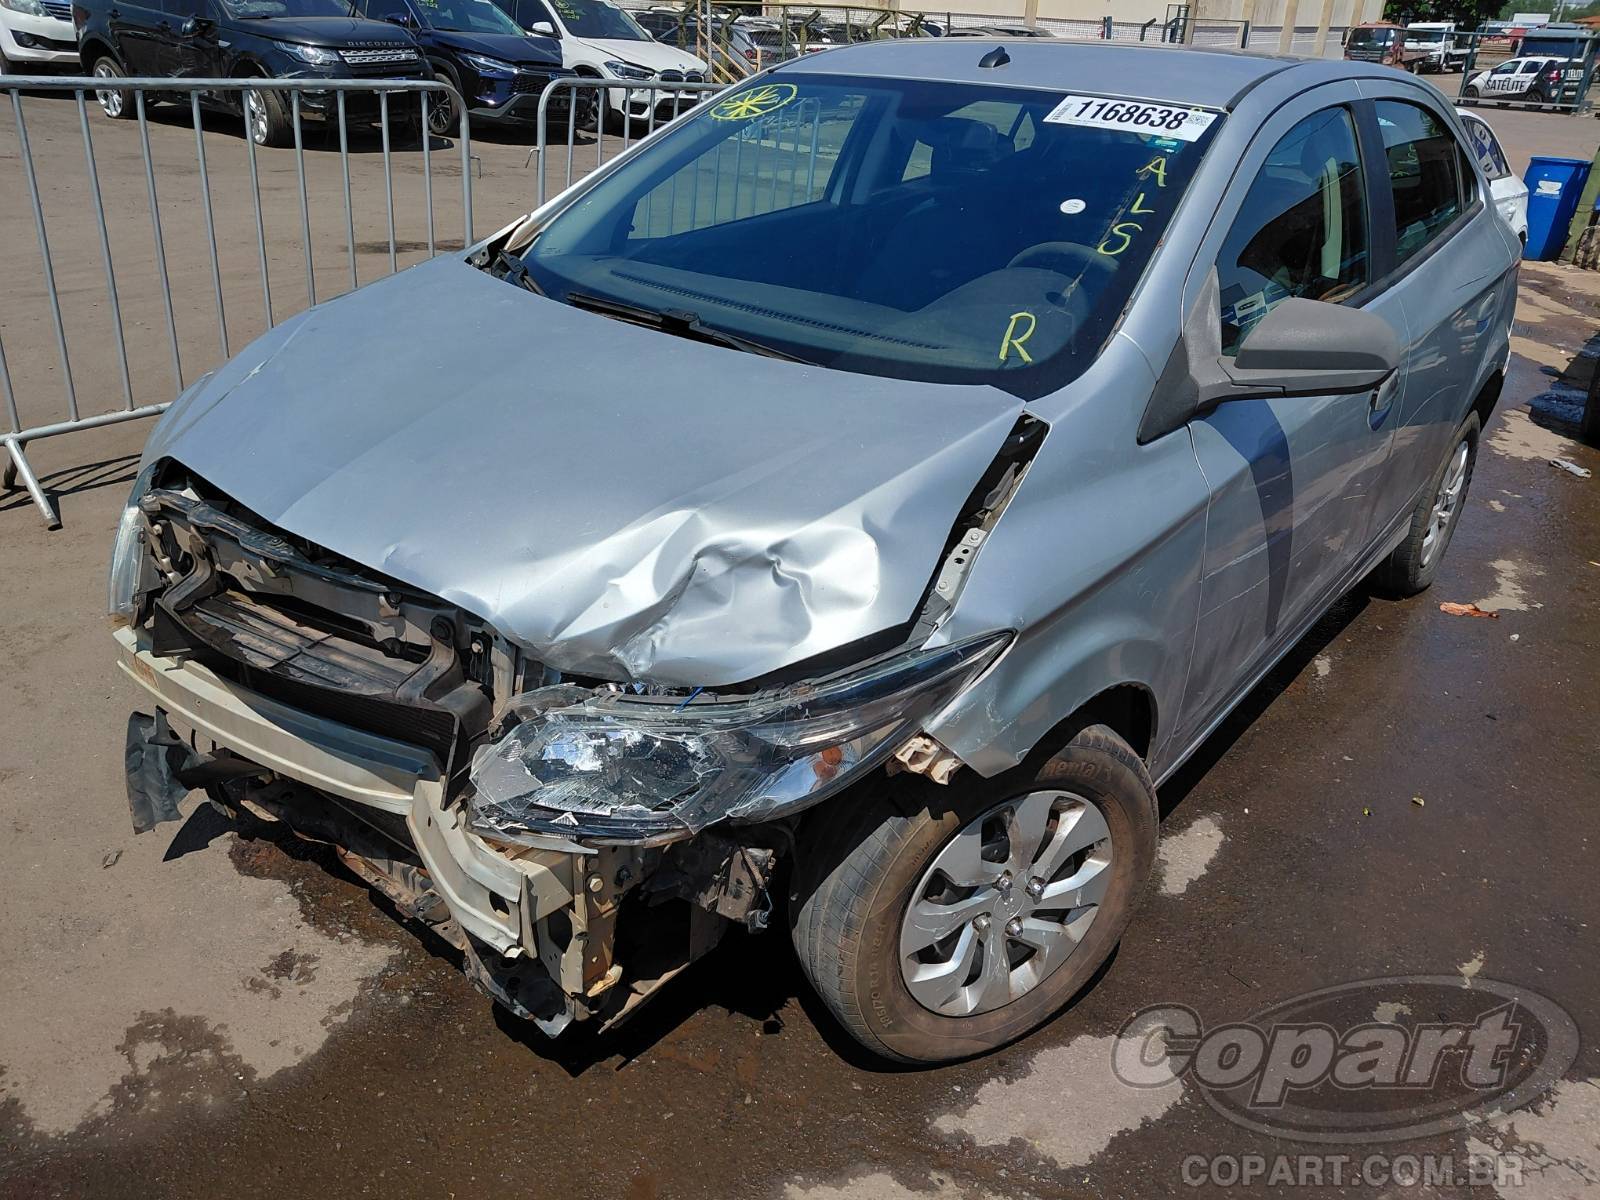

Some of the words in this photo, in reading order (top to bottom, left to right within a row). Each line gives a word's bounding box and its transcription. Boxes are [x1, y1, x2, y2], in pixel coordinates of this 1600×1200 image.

[1560, 68, 1585, 78] STÉLITE
[1075, 100, 1189, 130] 1168638
[999, 312, 1036, 363] R
